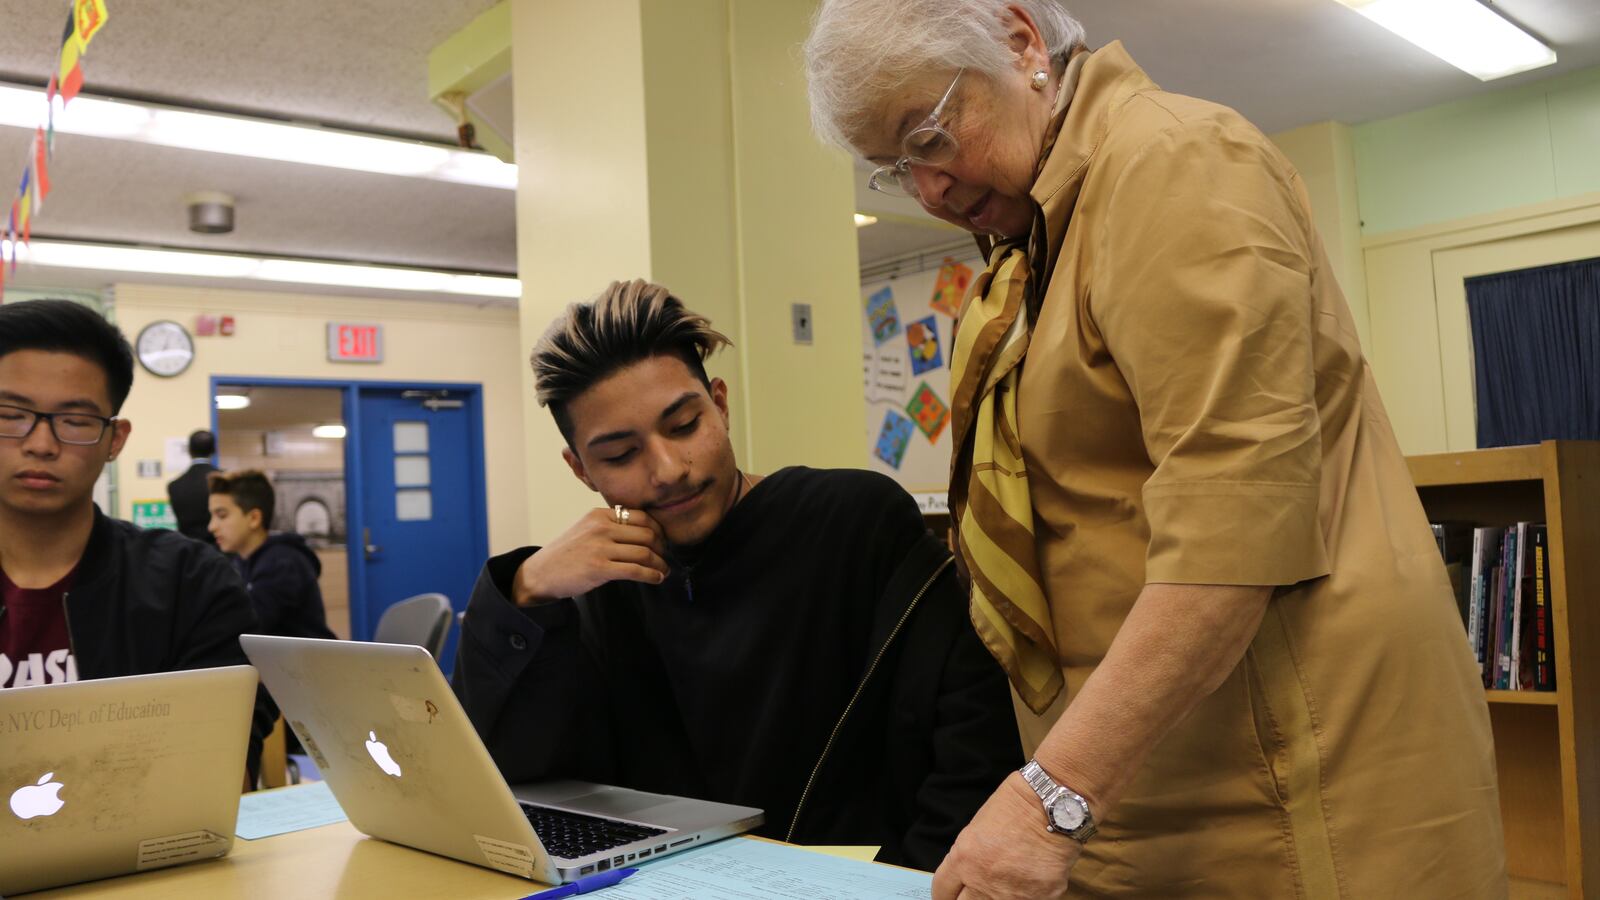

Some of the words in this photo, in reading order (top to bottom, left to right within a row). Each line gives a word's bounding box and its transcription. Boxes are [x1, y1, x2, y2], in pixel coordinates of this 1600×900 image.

[338, 325, 378, 358] EXIT
[8, 710, 46, 733] NYC
[89, 703, 107, 724] of
[106, 698, 170, 722] Education
